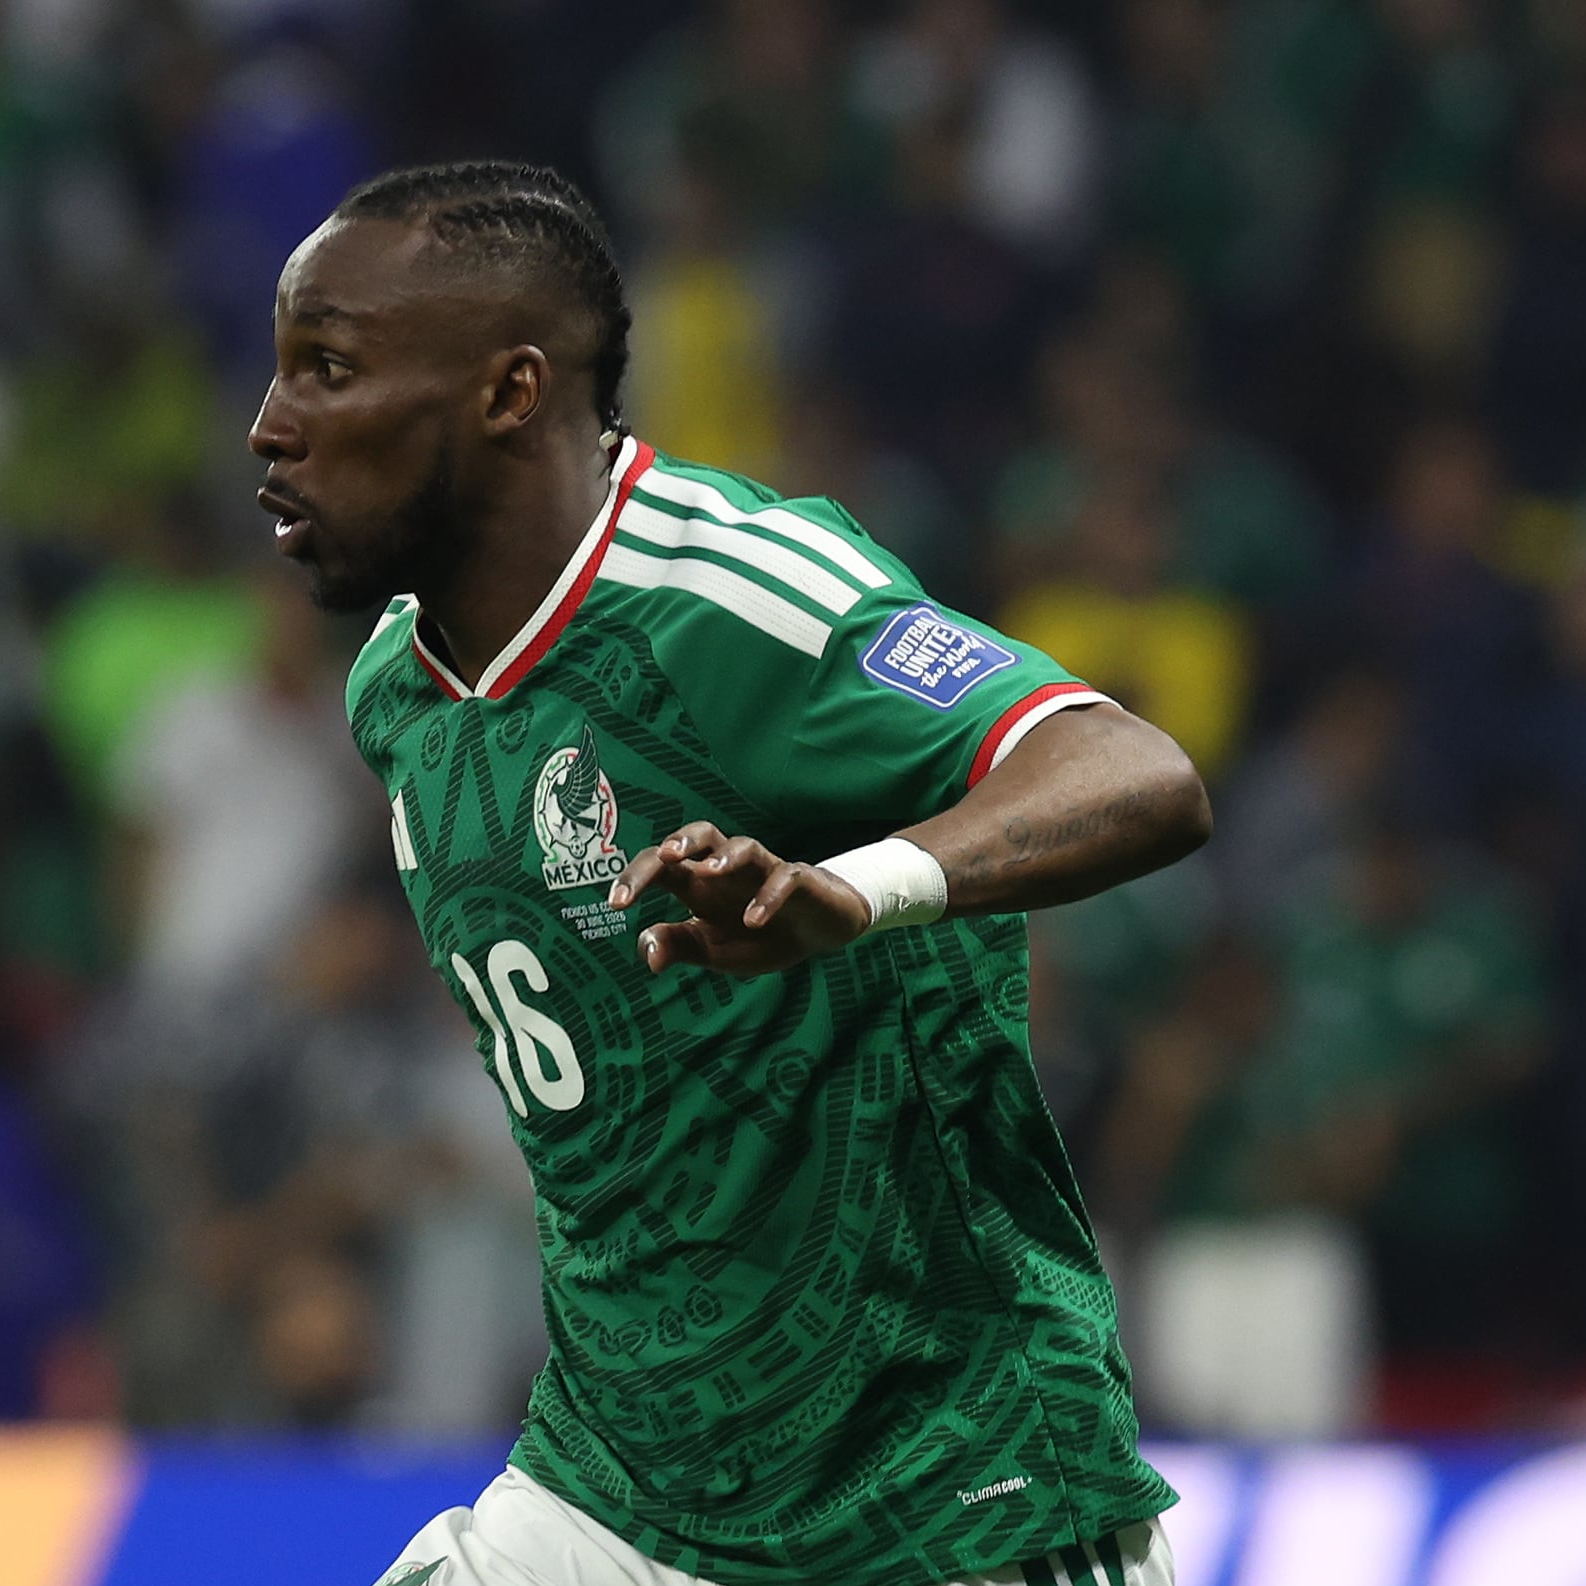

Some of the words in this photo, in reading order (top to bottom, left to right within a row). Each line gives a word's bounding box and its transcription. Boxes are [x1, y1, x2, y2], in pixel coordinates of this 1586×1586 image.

[920, 665, 947, 688] the
[951, 657, 981, 678] FIFA
[545, 854, 625, 888] MÉXICO
[451, 939, 585, 1119] 16
